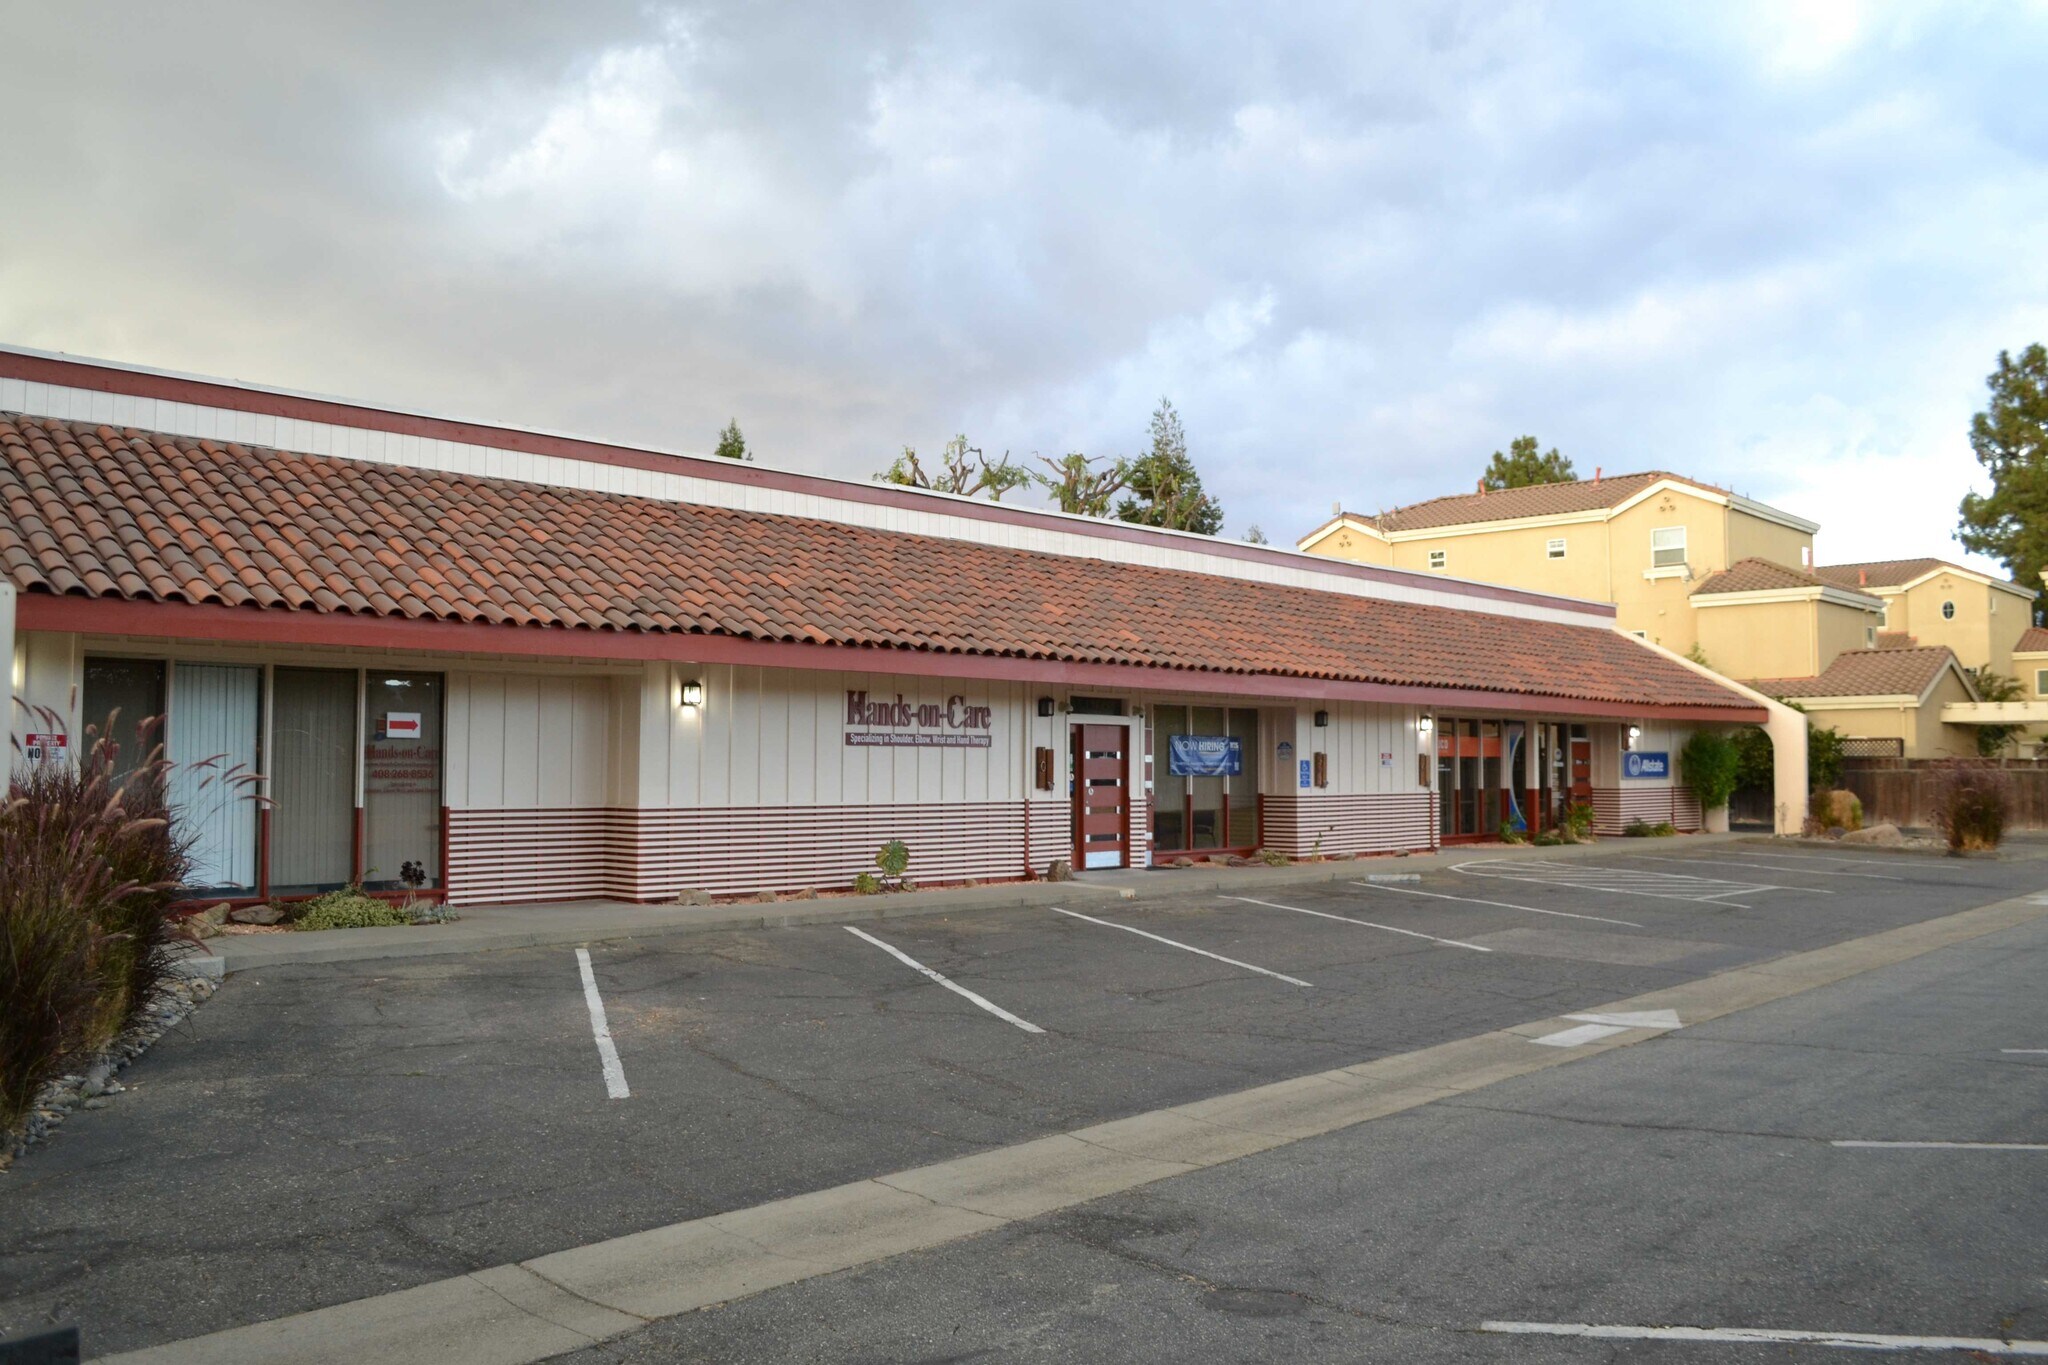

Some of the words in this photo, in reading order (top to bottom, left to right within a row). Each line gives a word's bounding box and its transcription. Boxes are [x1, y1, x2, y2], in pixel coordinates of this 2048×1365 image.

[846, 690, 992, 729] Hands-on-Care
[850, 733, 883, 745] Specializing
[946, 735, 957, 744] and
[957, 736, 969, 744] Hand
[970, 735, 989, 747] Therapy
[1174, 741, 1198, 752] NOW
[1199, 741, 1225, 752] HIRING
[28, 747, 41, 759] NO
[1641, 759, 1664, 772] Allstate
